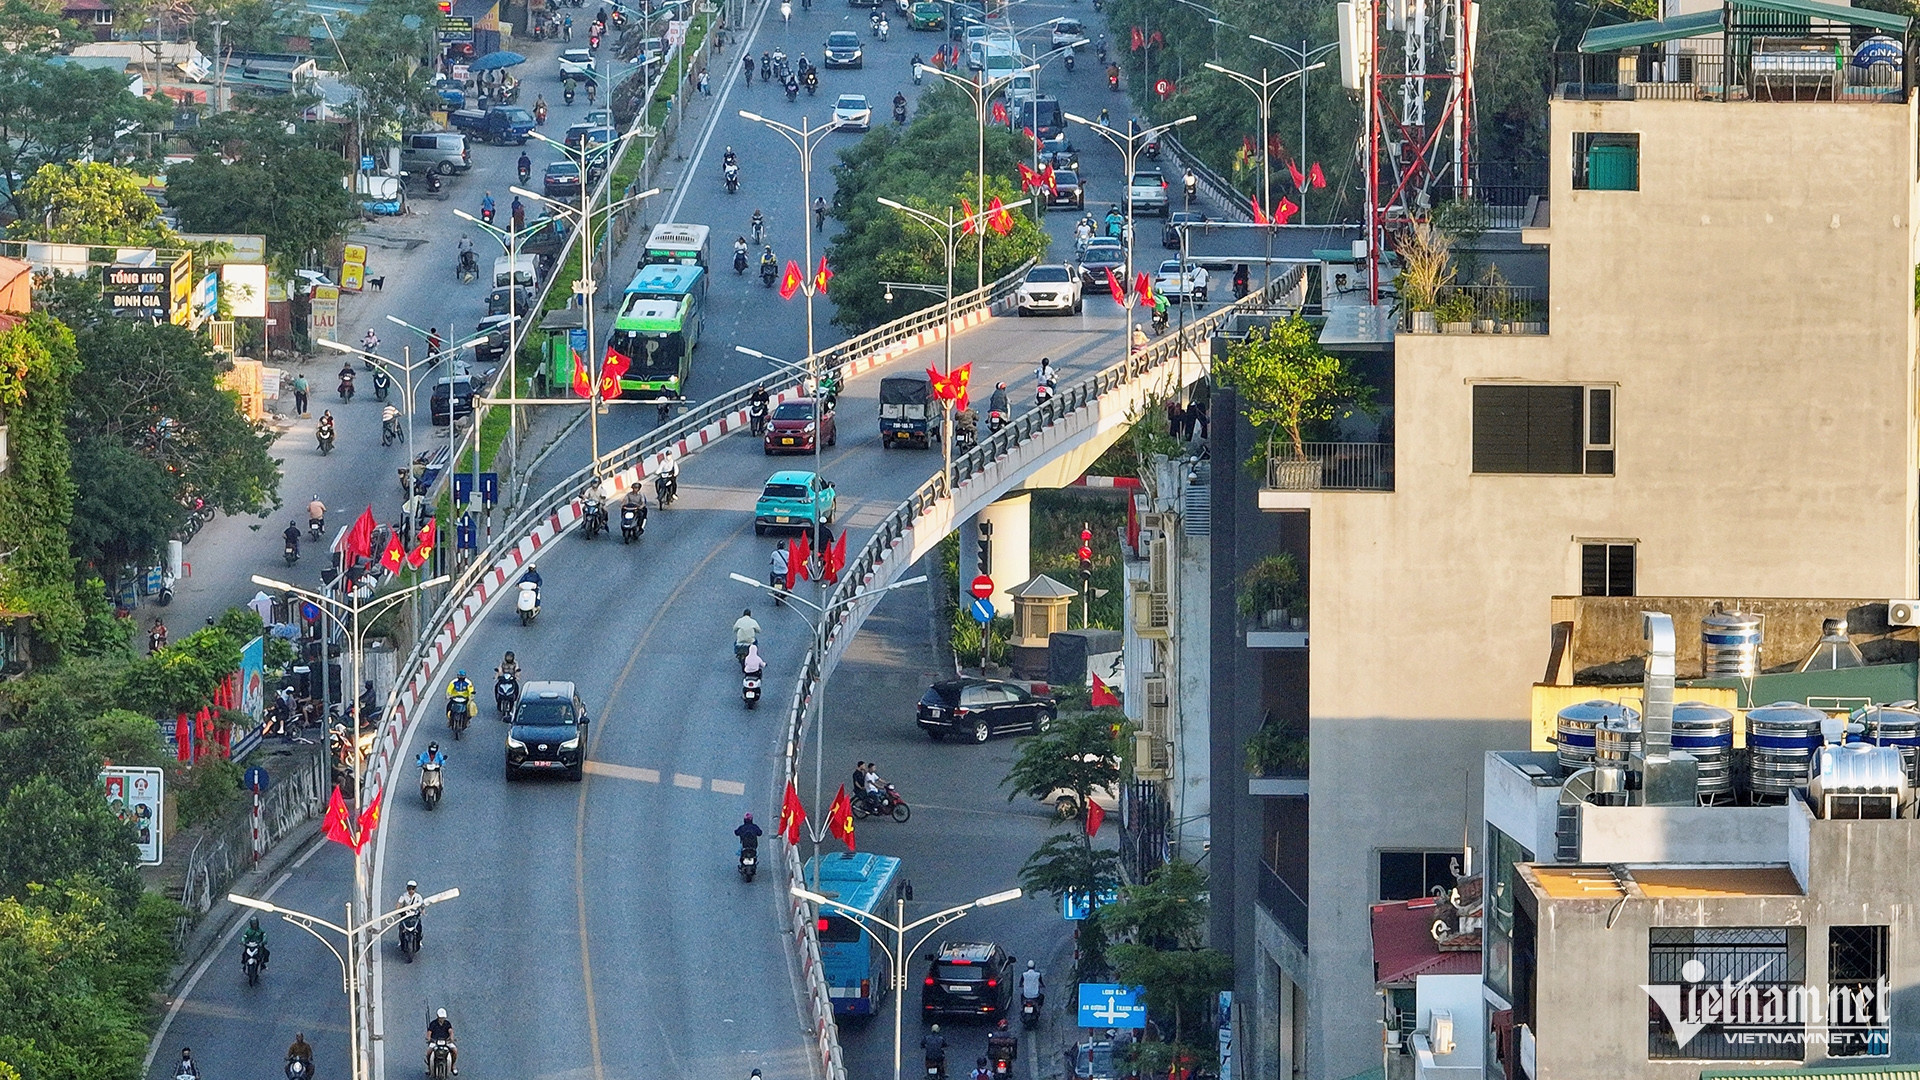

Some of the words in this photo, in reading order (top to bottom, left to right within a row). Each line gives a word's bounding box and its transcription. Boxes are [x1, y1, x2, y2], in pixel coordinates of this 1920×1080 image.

[110, 269, 139, 284] TỔNG
[141, 273, 165, 284] KHO
[142, 295, 161, 307] GIA
